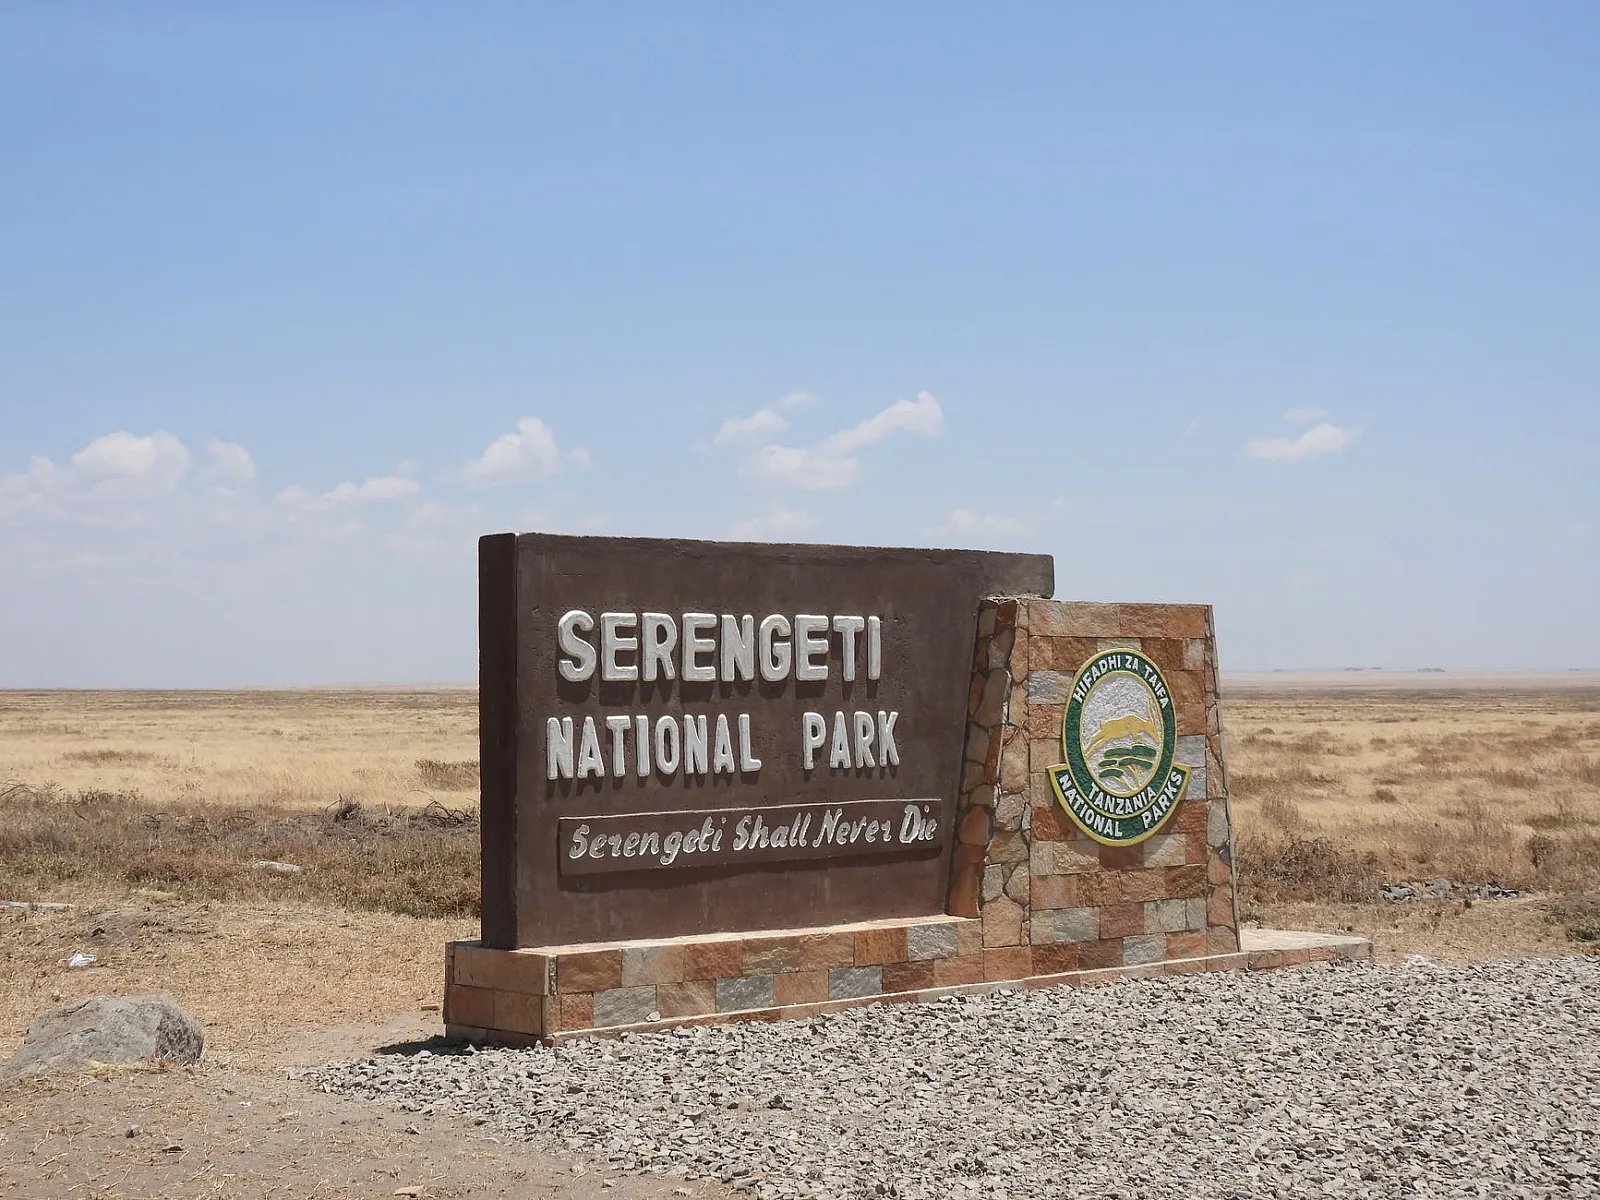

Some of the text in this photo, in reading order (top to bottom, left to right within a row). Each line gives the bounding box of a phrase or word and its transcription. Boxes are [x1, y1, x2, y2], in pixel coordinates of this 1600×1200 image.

[558, 610, 881, 682] SERENGETI
[1073, 655, 1170, 709] HIFADHI ZA TAIFA
[546, 710, 900, 780] NATIONAL PARK
[1058, 771, 1183, 837] NATIONAL PARKS
[1088, 782, 1157, 815] TANZANIA
[568, 804, 938, 866] Serengeti Shall Never Die
